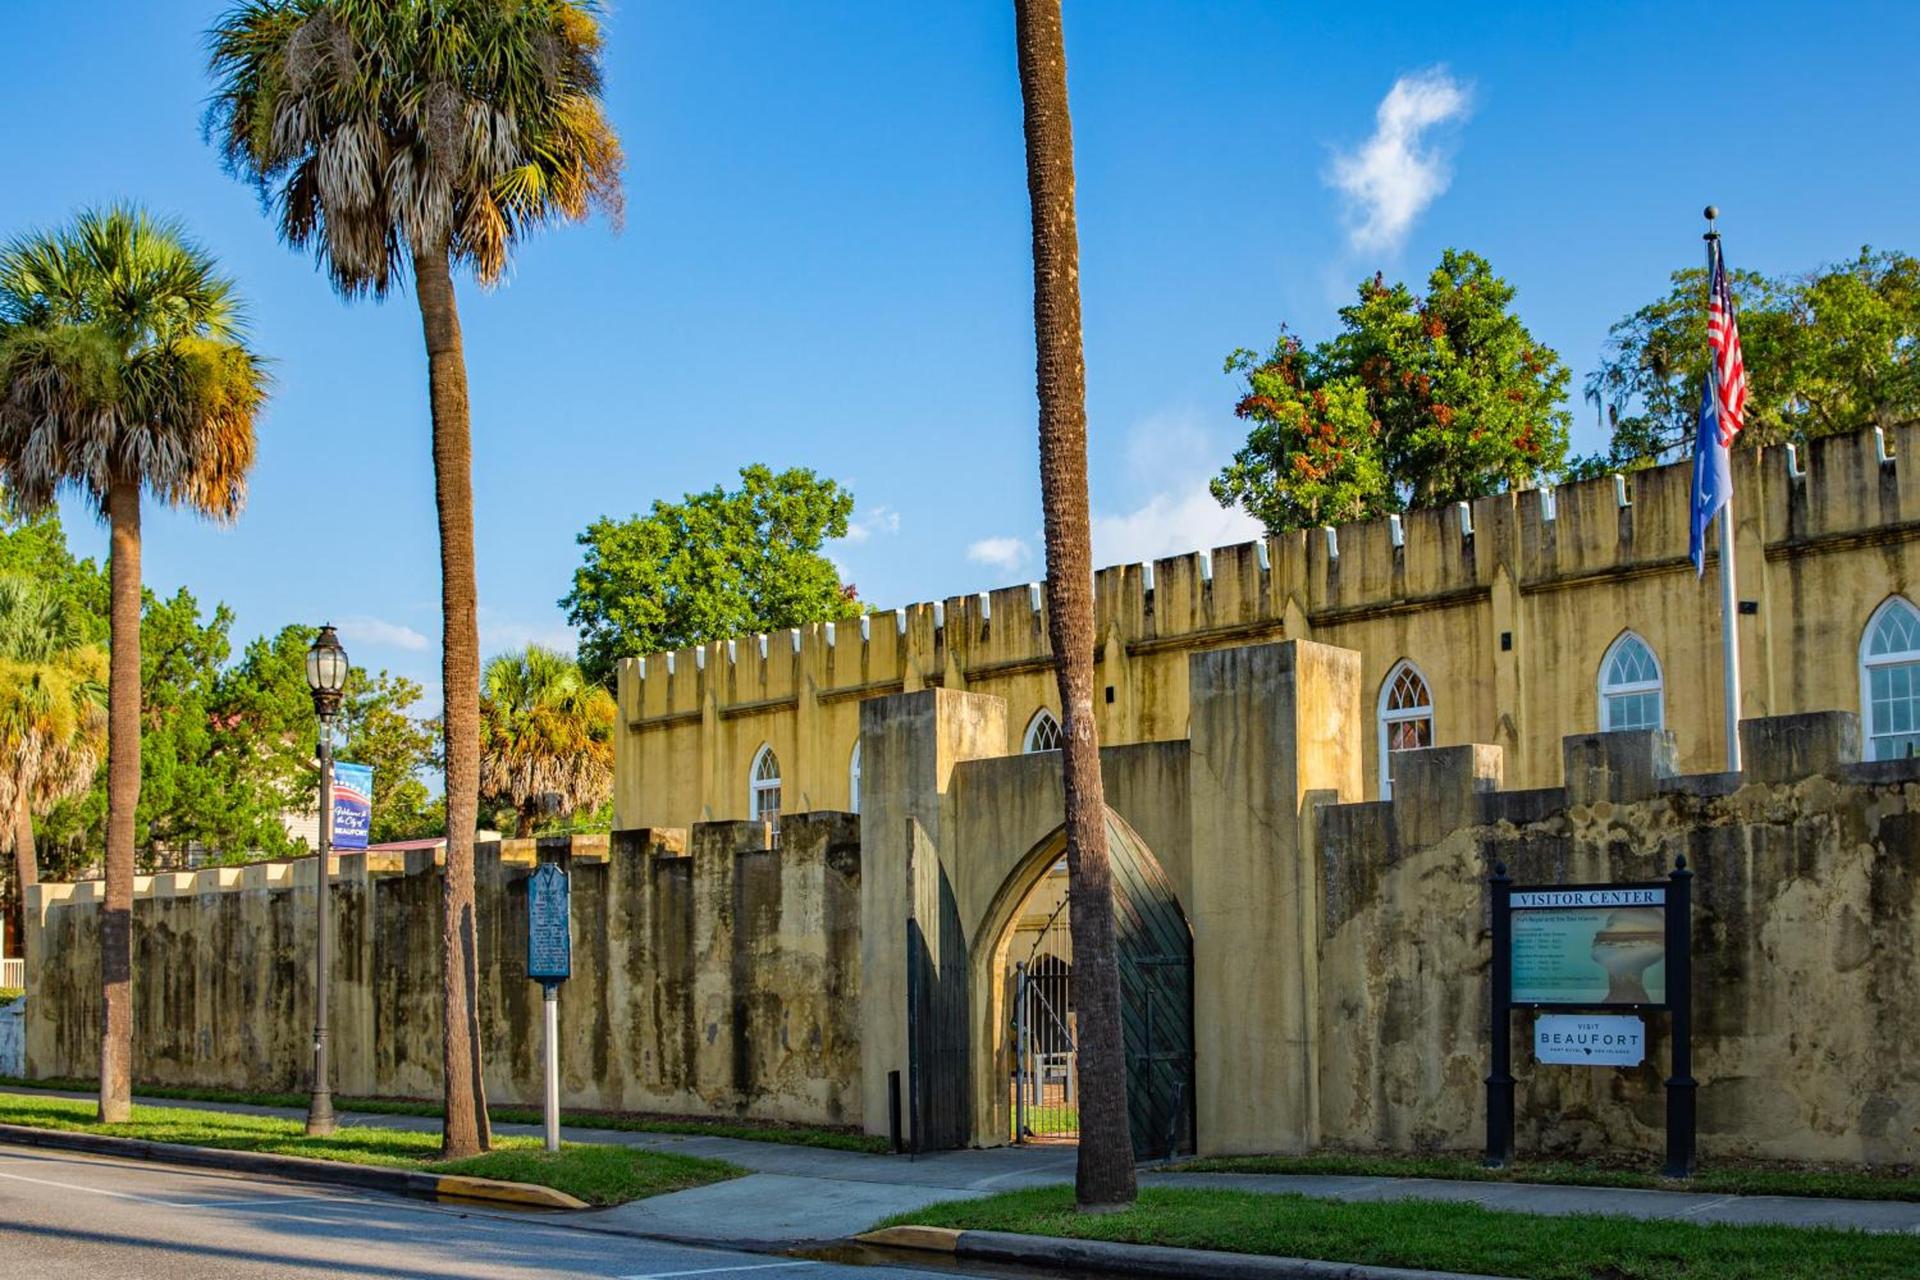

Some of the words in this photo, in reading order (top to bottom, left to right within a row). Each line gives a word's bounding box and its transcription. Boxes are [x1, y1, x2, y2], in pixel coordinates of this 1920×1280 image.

[336, 816, 345, 824] the
[345, 816, 357, 827] City
[357, 819, 365, 828] of
[334, 827, 368, 837] BEAUFORT
[1520, 893, 1584, 906] VISITOR
[1589, 891, 1654, 904] CENTER
[1540, 1033, 1639, 1045] BEAUFORT
